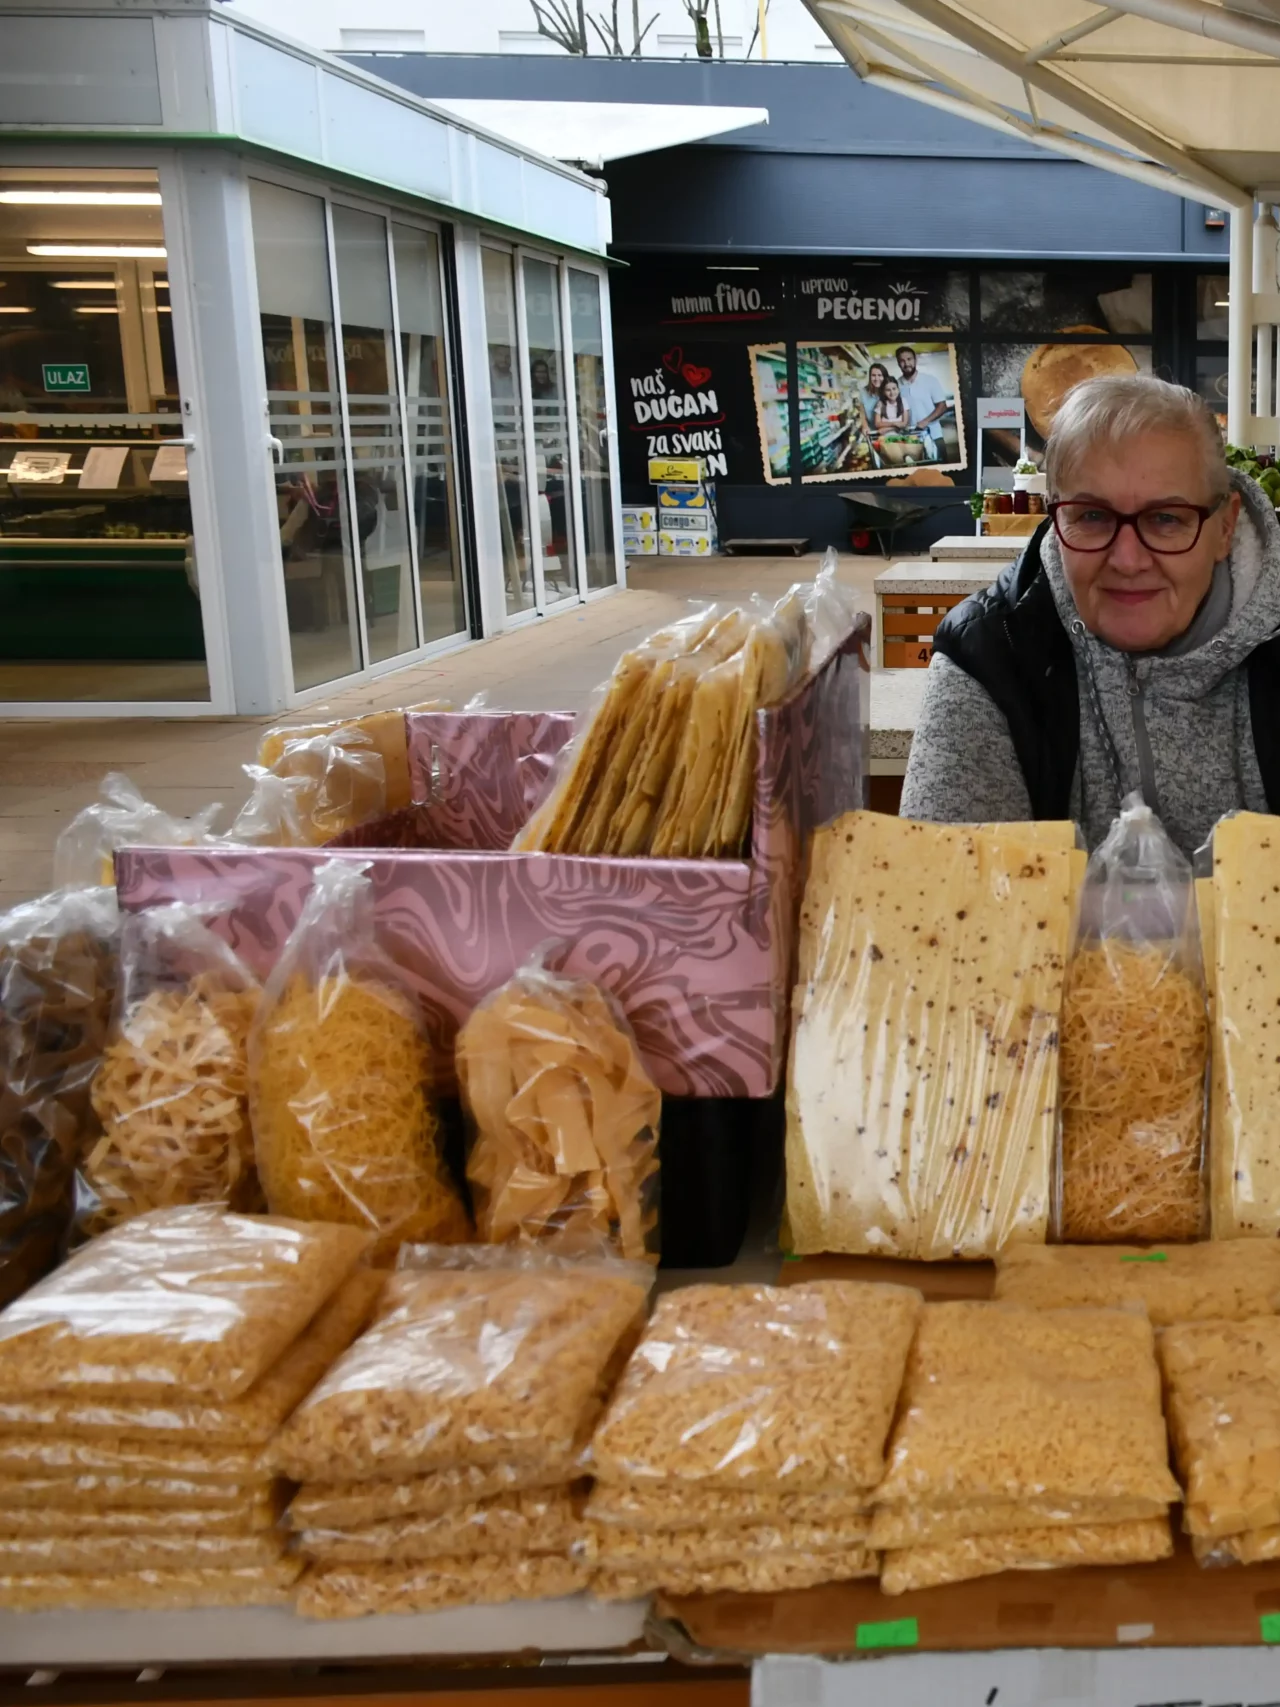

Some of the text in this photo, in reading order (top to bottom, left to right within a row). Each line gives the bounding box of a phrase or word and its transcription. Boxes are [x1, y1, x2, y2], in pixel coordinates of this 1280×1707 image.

[801, 277, 849, 295] upravo
[671, 295, 714, 314] mmm
[817, 290, 921, 322] PEČENO!
[47, 371, 86, 385] ULAZ
[630, 369, 666, 397] naš
[633, 388, 719, 424] DUĆAN
[647, 427, 723, 456] za svaki
